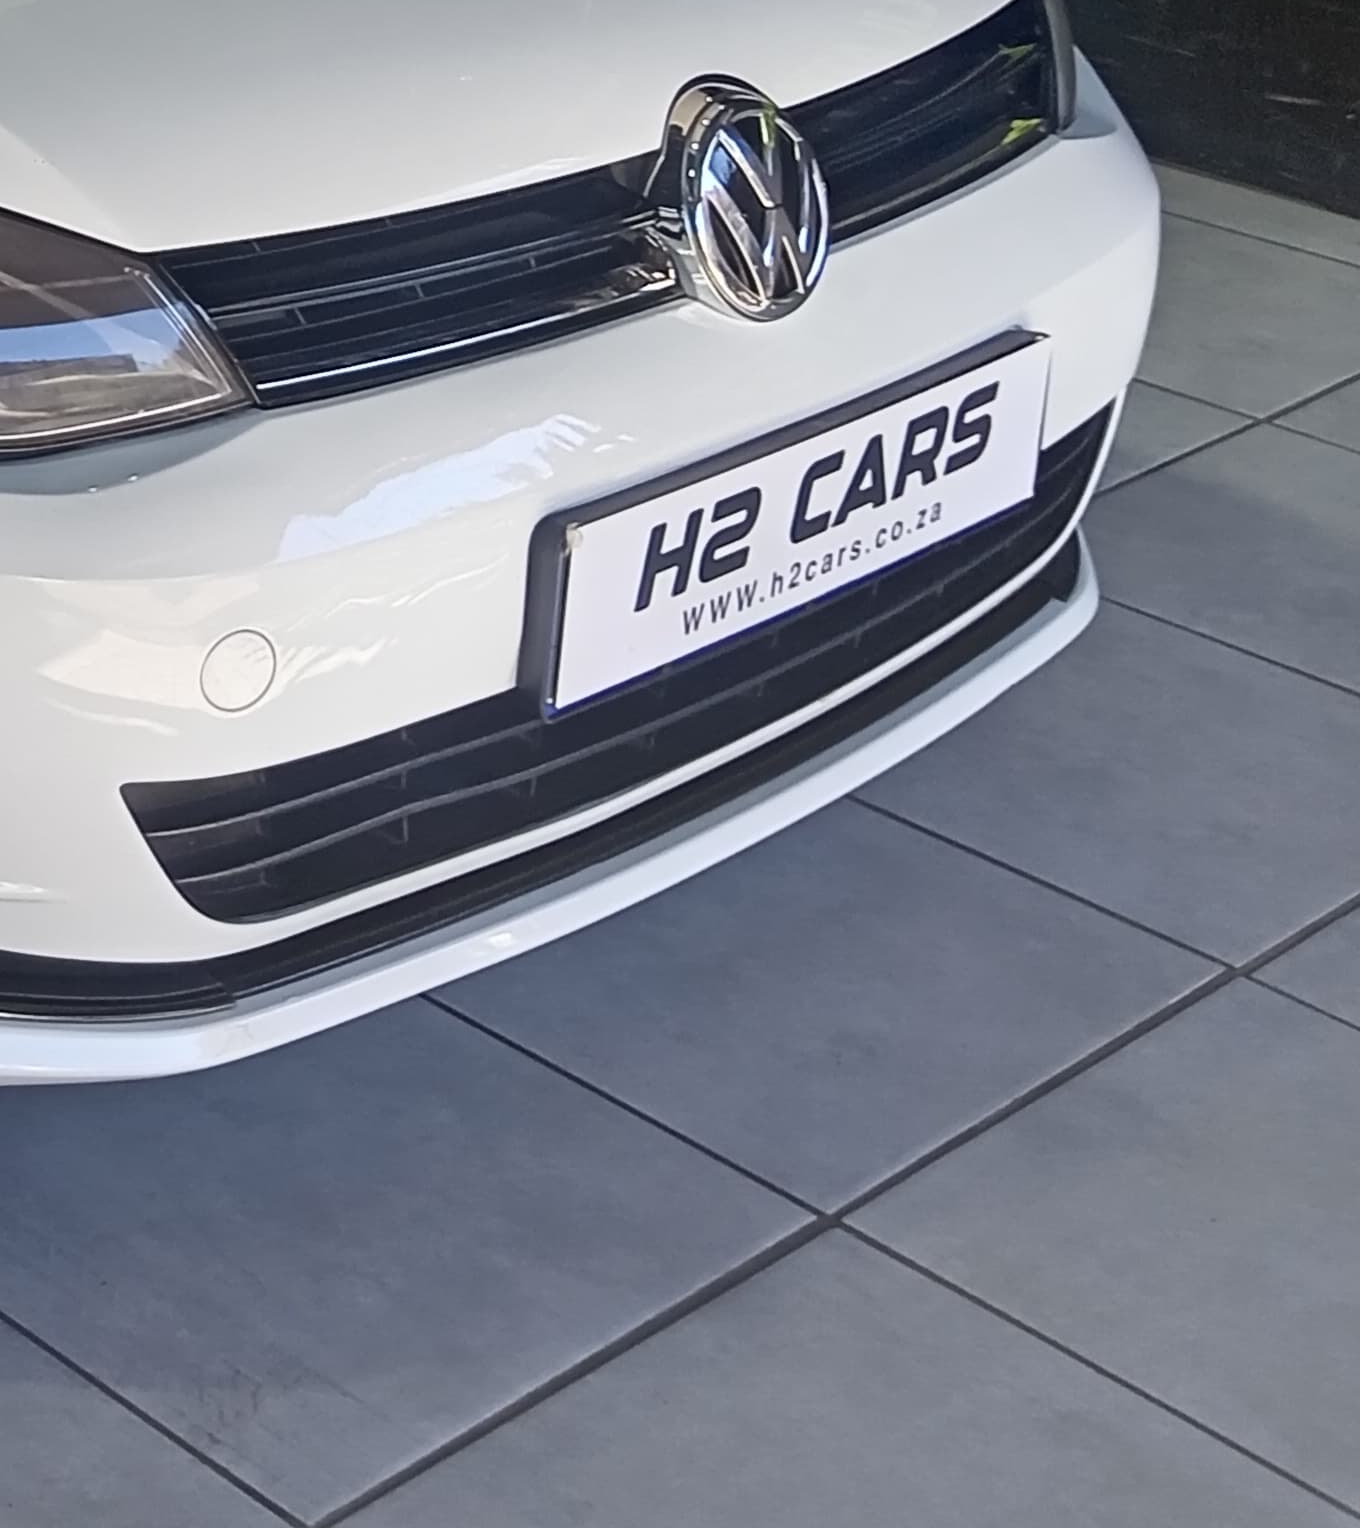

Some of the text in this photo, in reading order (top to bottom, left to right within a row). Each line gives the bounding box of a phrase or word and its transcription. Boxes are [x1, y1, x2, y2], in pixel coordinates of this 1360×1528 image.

[633, 380, 1000, 612] H2 CARS
[682, 501, 942, 636] www.h2cars.co.za
